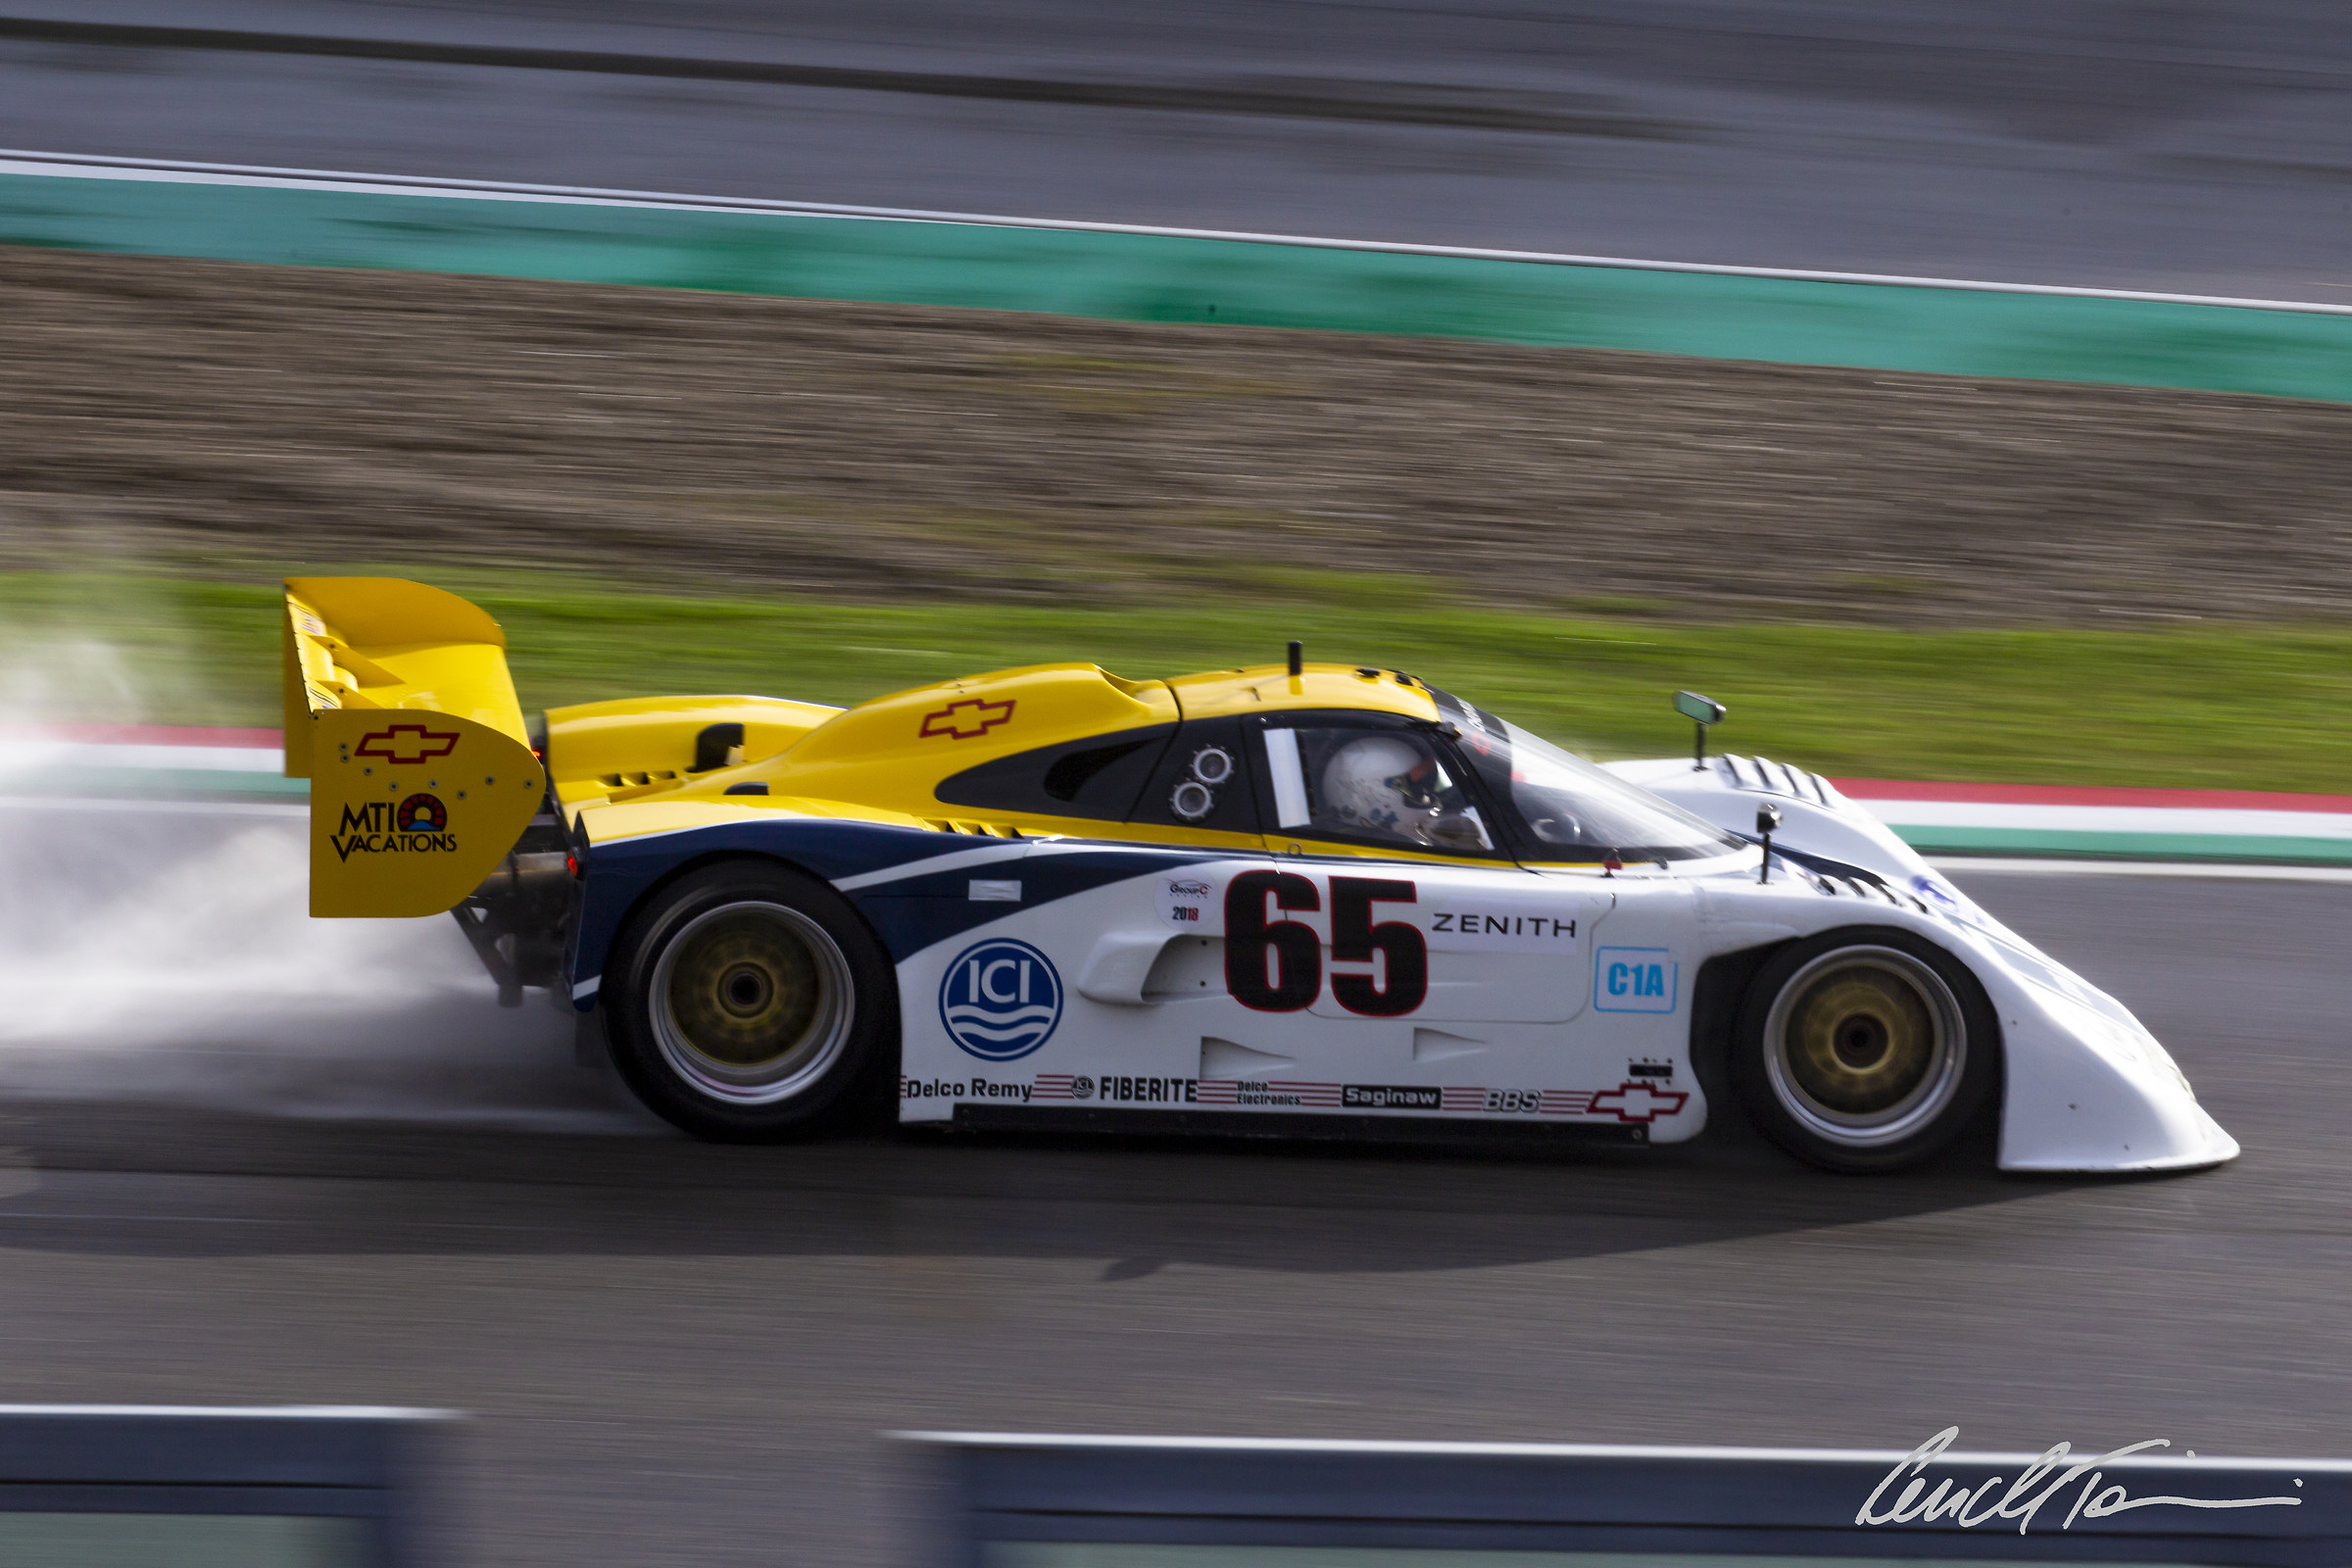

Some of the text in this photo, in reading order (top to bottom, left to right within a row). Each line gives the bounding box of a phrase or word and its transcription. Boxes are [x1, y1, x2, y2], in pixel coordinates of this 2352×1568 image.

[338, 802, 395, 836] MTI
[329, 833, 458, 863] VACATIONS
[1172, 906, 1200, 922] 2018
[1431, 912, 1577, 939] ZENITH
[1224, 869, 1428, 1017] 65
[968, 958, 1031, 1004] ICI
[1607, 961, 1665, 998] C1A
[906, 1077, 1033, 1103] Delco Remy
[1100, 1076, 1199, 1102] FIBERITE
[1236, 1080, 1268, 1092] Delco
[1236, 1092, 1302, 1106] Electronics
[1346, 1087, 1438, 1106] Saginaw
[1482, 1088, 1542, 1113] BBS
